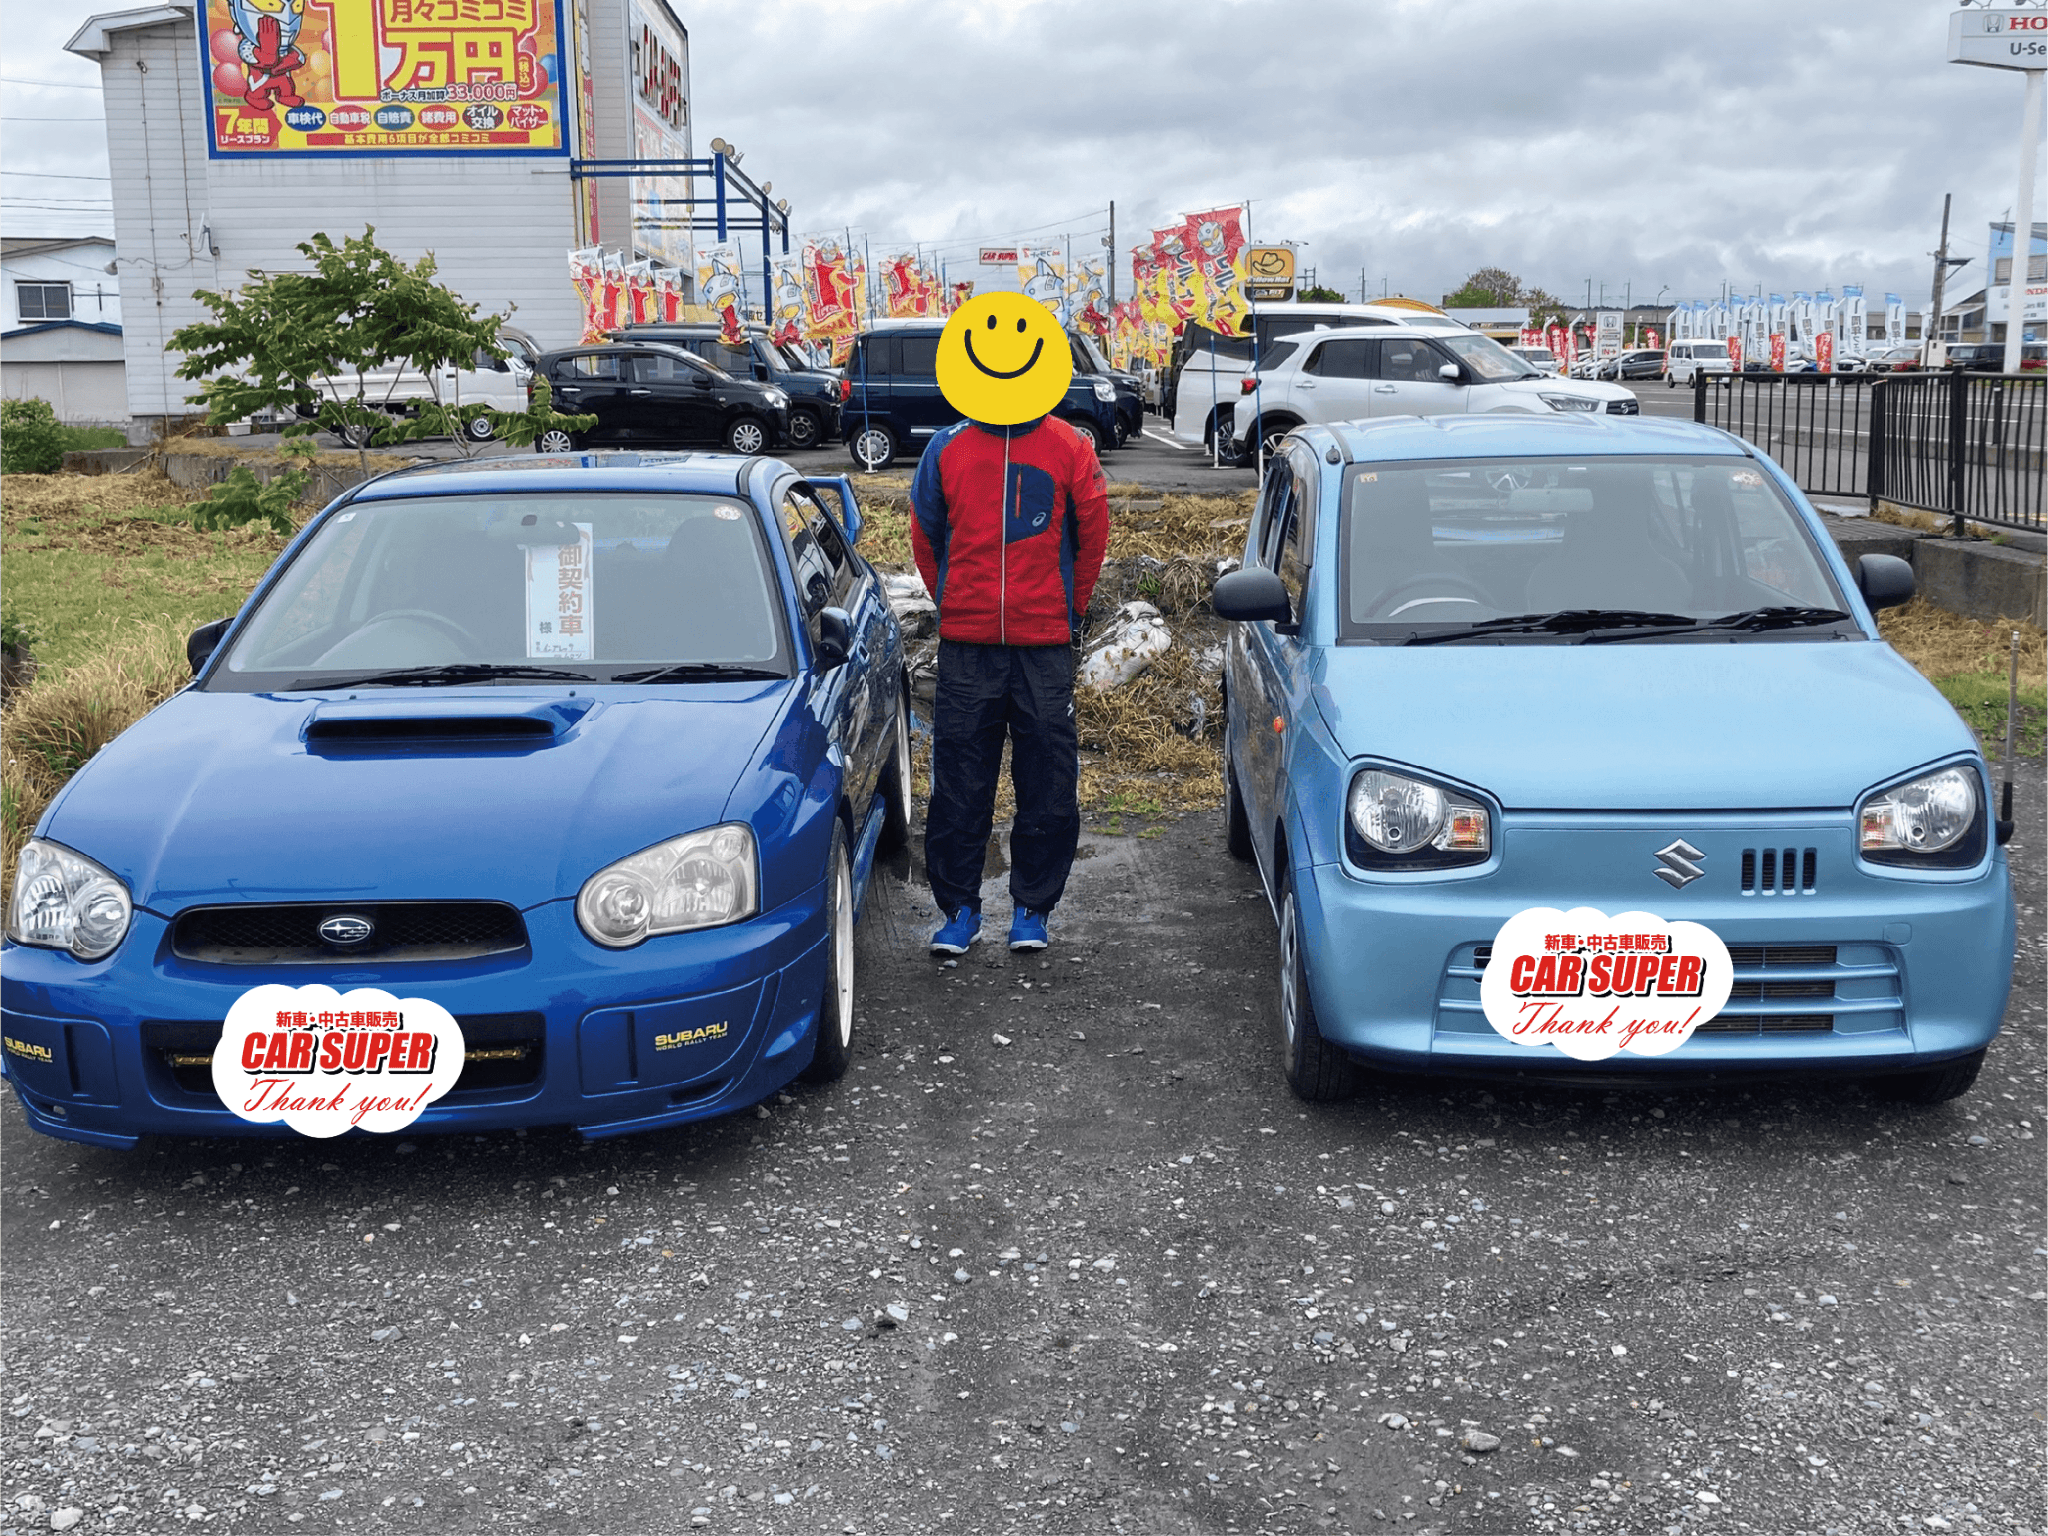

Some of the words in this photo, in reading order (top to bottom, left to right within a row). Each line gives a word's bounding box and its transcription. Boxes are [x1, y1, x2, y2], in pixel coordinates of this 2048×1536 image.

[390, 0, 527, 22] 月々コミコミ
[421, 111, 457, 124] 諸費用
[467, 106, 499, 117] オイル
[218, 108, 269, 135] 7年間
[287, 112, 323, 125] 車検代
[330, 112, 371, 125] 自動車税
[472, 117, 495, 129] 交換
[510, 117, 548, 129] バイザー
[220, 135, 270, 144] リースプラン
[558, 544, 584, 637] 御契約車
[539, 621, 552, 634] 様
[655, 1020, 728, 1046] SUBARU
[4, 1036, 52, 1059] SUBARU
